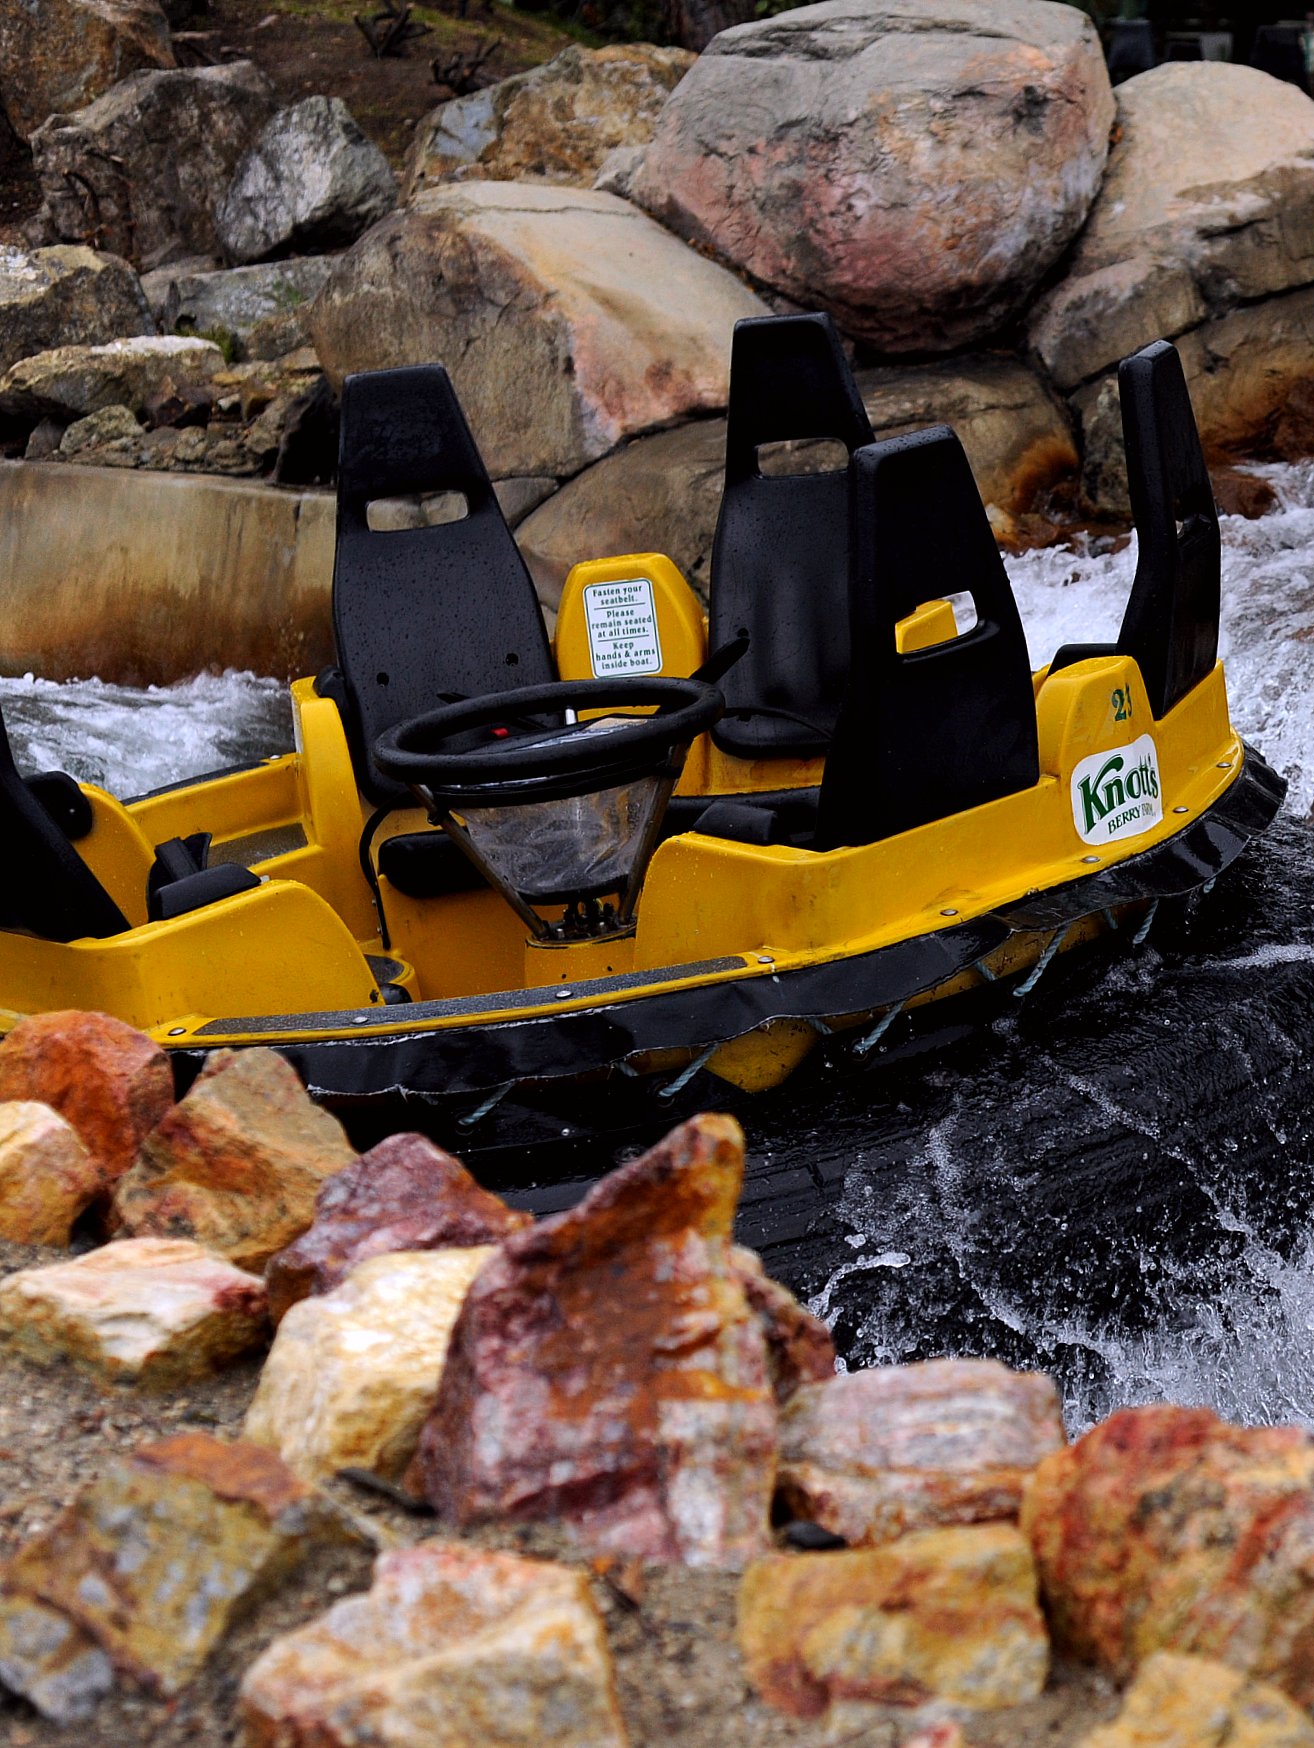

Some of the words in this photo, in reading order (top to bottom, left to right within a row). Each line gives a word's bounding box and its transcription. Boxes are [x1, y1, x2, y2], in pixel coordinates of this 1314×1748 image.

[593, 588, 620, 597] Fasten
[623, 585, 642, 595] your
[601, 594, 638, 605] seatbelt.
[607, 609, 634, 618] Please
[592, 619, 622, 629] remain
[625, 615, 652, 625] seated
[598, 630, 606, 638] at
[609, 628, 620, 637] all
[622, 626, 649, 636] times.
[613, 642, 634, 650] Keep
[596, 651, 622, 661] hands
[624, 650, 631, 658] &
[634, 649, 655, 657] arms
[602, 660, 628, 670] inside
[630, 658, 652, 666] boat.
[1077, 753, 1159, 834] Knott's
[1107, 804, 1141, 835] BERRY
